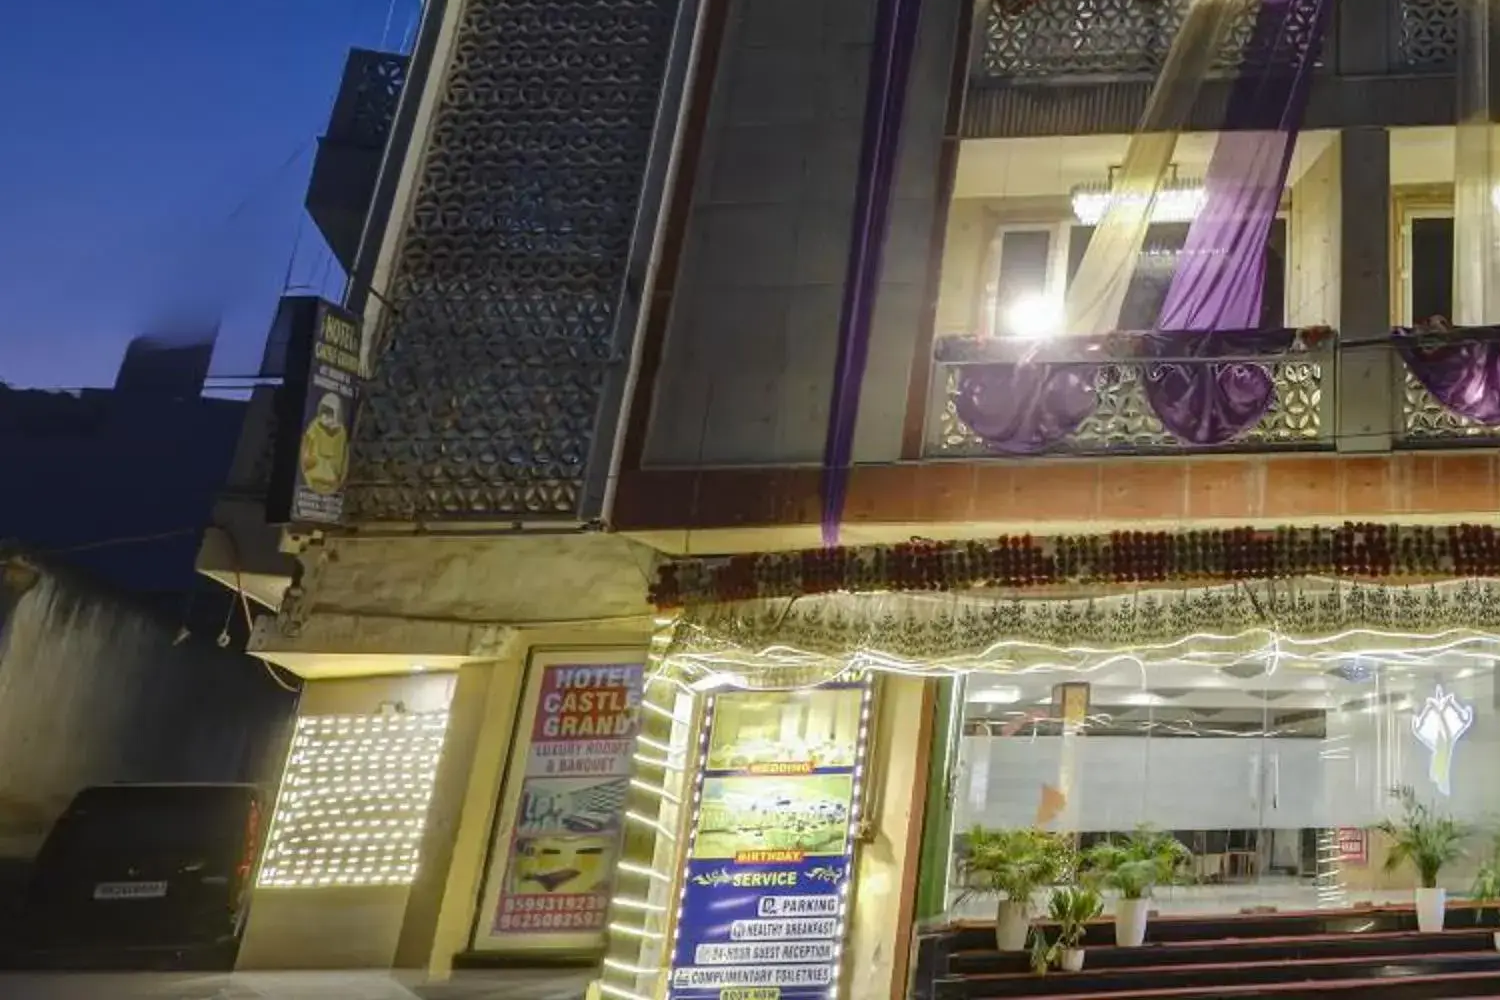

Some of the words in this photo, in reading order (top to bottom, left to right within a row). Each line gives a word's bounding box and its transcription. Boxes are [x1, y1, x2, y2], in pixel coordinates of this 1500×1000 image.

[555, 668, 638, 689] HOTEL
[543, 688, 641, 713] CASTLE
[543, 714, 634, 738] GRAND
[558, 757, 616, 773] BANQUET
[737, 851, 801, 862] BIRTHDAY
[732, 871, 798, 888] SERVICE
[781, 899, 836, 914] PARKING
[748, 924, 783, 939] HEALTHY
[785, 922, 834, 938] BREAKFAST
[752, 946, 780, 961] GUEST
[781, 943, 831, 959] RECEPTION
[691, 971, 774, 986] COMPLIMENTARY
[775, 969, 829, 984] TOILETRIES
